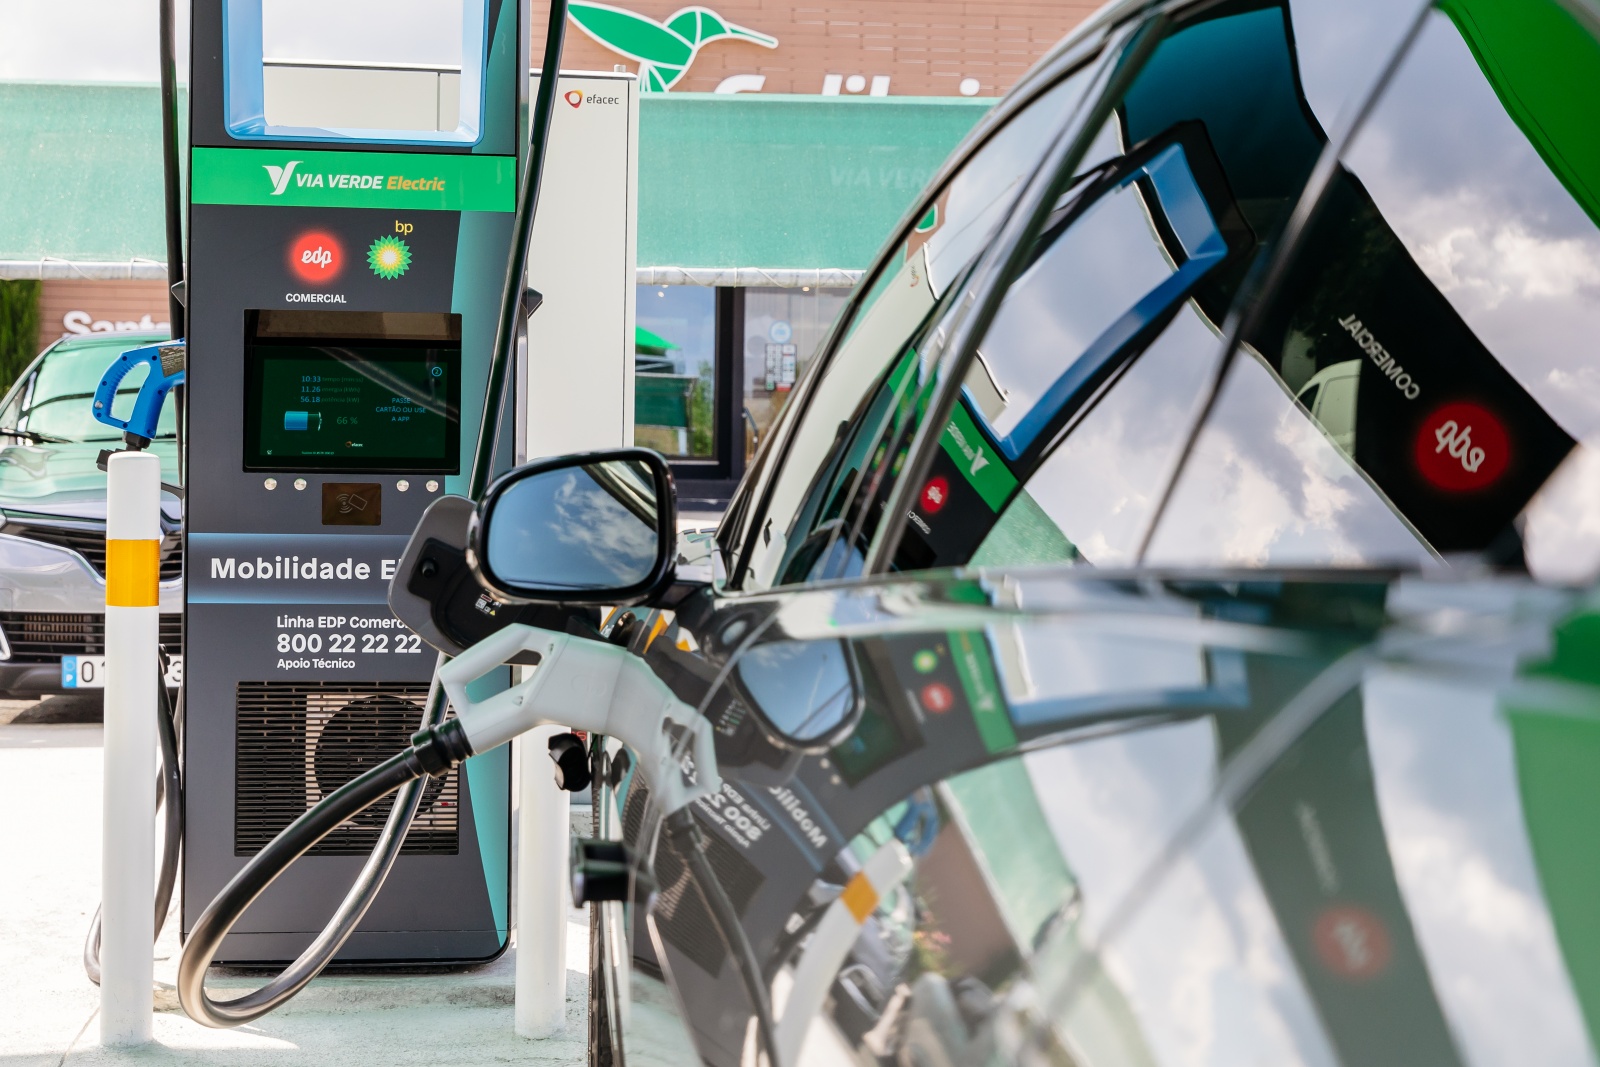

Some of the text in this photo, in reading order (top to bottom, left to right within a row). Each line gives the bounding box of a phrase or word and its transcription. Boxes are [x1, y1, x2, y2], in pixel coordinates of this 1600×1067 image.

[586, 94, 619, 105] efacec
[296, 173, 446, 192] VIA VERDE Electric
[395, 220, 413, 236] bp
[301, 246, 332, 268] edp
[285, 293, 347, 304] COMERCIAL
[301, 375, 321, 383] 10:33
[336, 416, 348, 425] 66
[210, 556, 371, 580] Mobilidade
[276, 615, 314, 628] Linha
[318, 616, 346, 629] EDP
[276, 633, 422, 654] 800 22 22 22
[276, 657, 355, 670] Apoio Técnico
